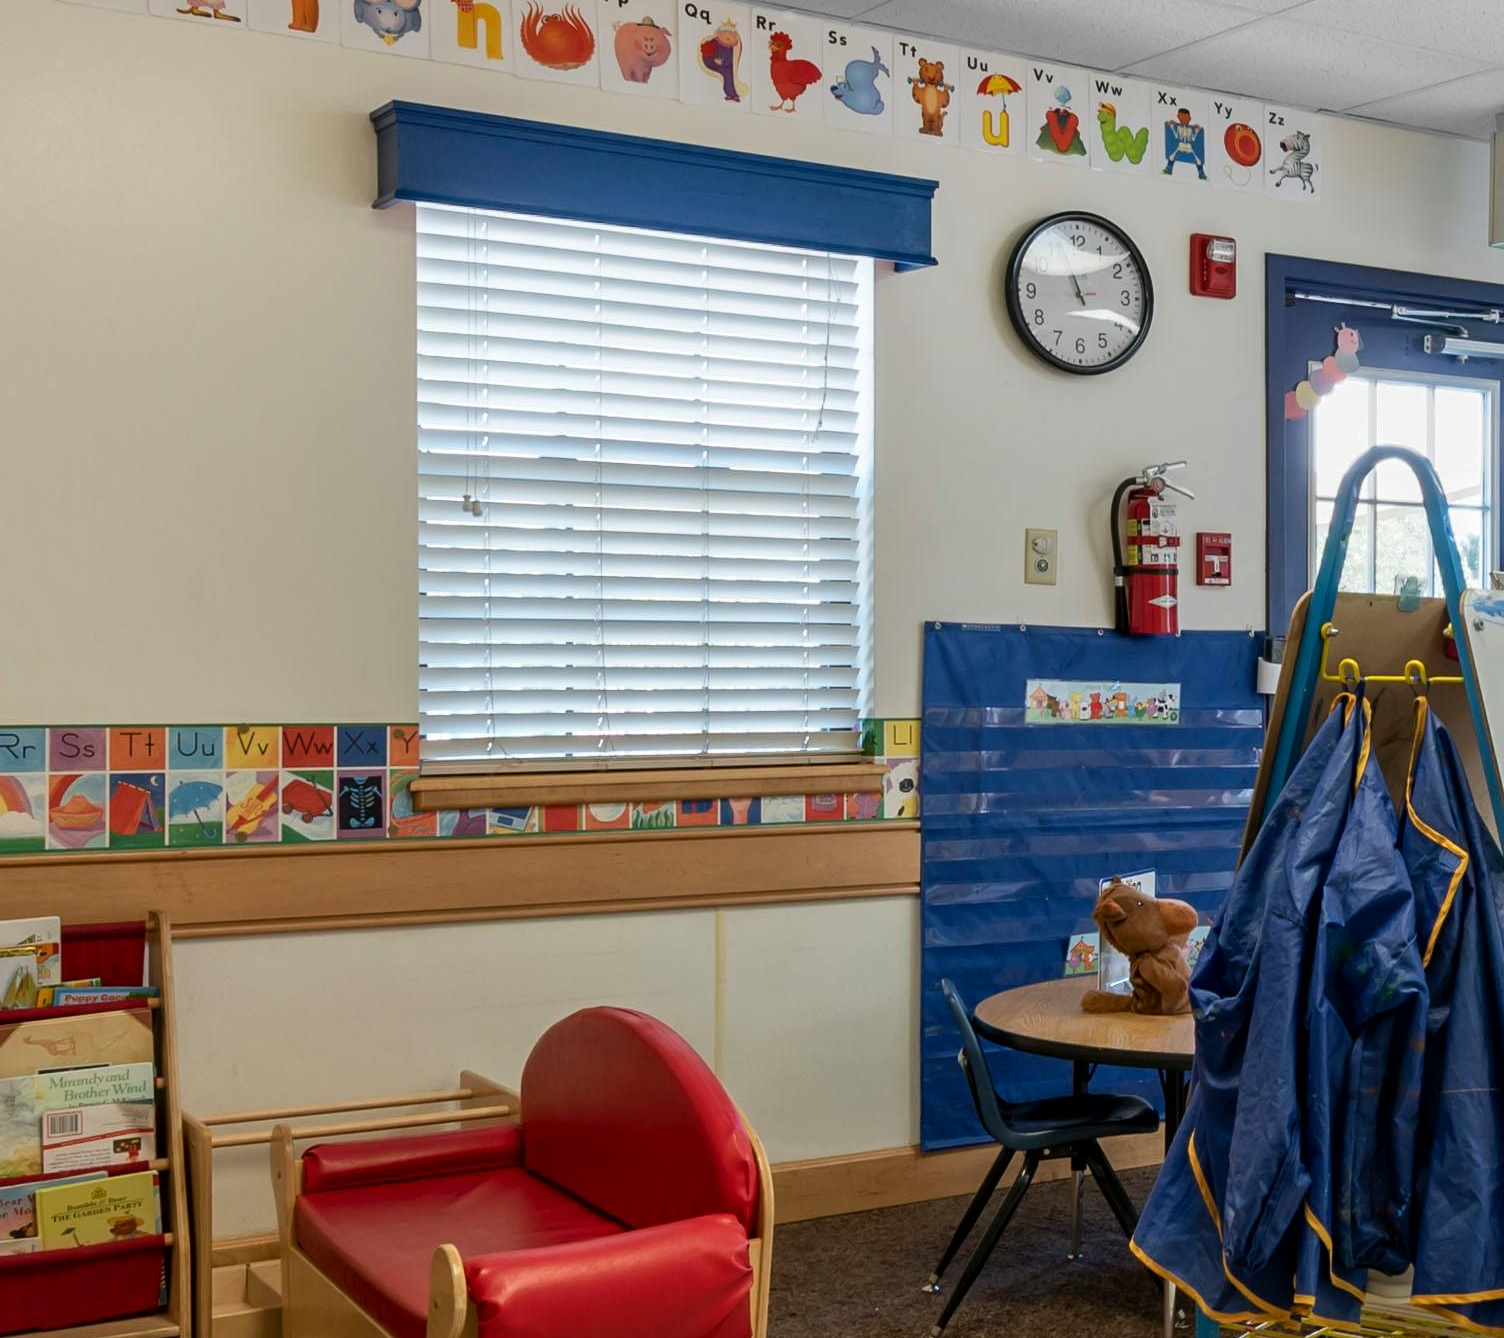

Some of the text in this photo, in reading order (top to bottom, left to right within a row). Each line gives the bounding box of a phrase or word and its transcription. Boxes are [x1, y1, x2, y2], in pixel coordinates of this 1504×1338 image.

[685, 3, 711, 25] Qq
[756, 16, 777, 32] Rr
[829, 31, 847, 46] Ss
[900, 42, 917, 58] Tt
[968, 56, 988, 72] Uu
[1034, 68, 1054, 85] Vv
[1096, 80, 1123, 97] Ww
[1158, 91, 1178, 106] Xx
[1214, 102, 1233, 119] Yy
[1268, 112, 1285, 128] Zz
[1070, 235, 1085, 247] 12
[1113, 263, 1122, 279] 2
[1026, 283, 1036, 299] 9
[1121, 291, 1130, 306] 3
[1035, 309, 1044, 325] 8
[1053, 330, 1062, 345] 7
[1076, 338, 1085, 353] 6
[1098, 333, 1107, 348] 5
[60, 733, 95, 759] Ss
[121, 733, 155, 760] Tt
[178, 733, 215, 759] Uu
[236, 732, 269, 759] Vv
[283, 732, 333, 758] Ww
[344, 732, 378, 756] Xx
[49, 1070, 129, 1089] Mirandy and
[65, 1082, 146, 1102] Brother Wind
